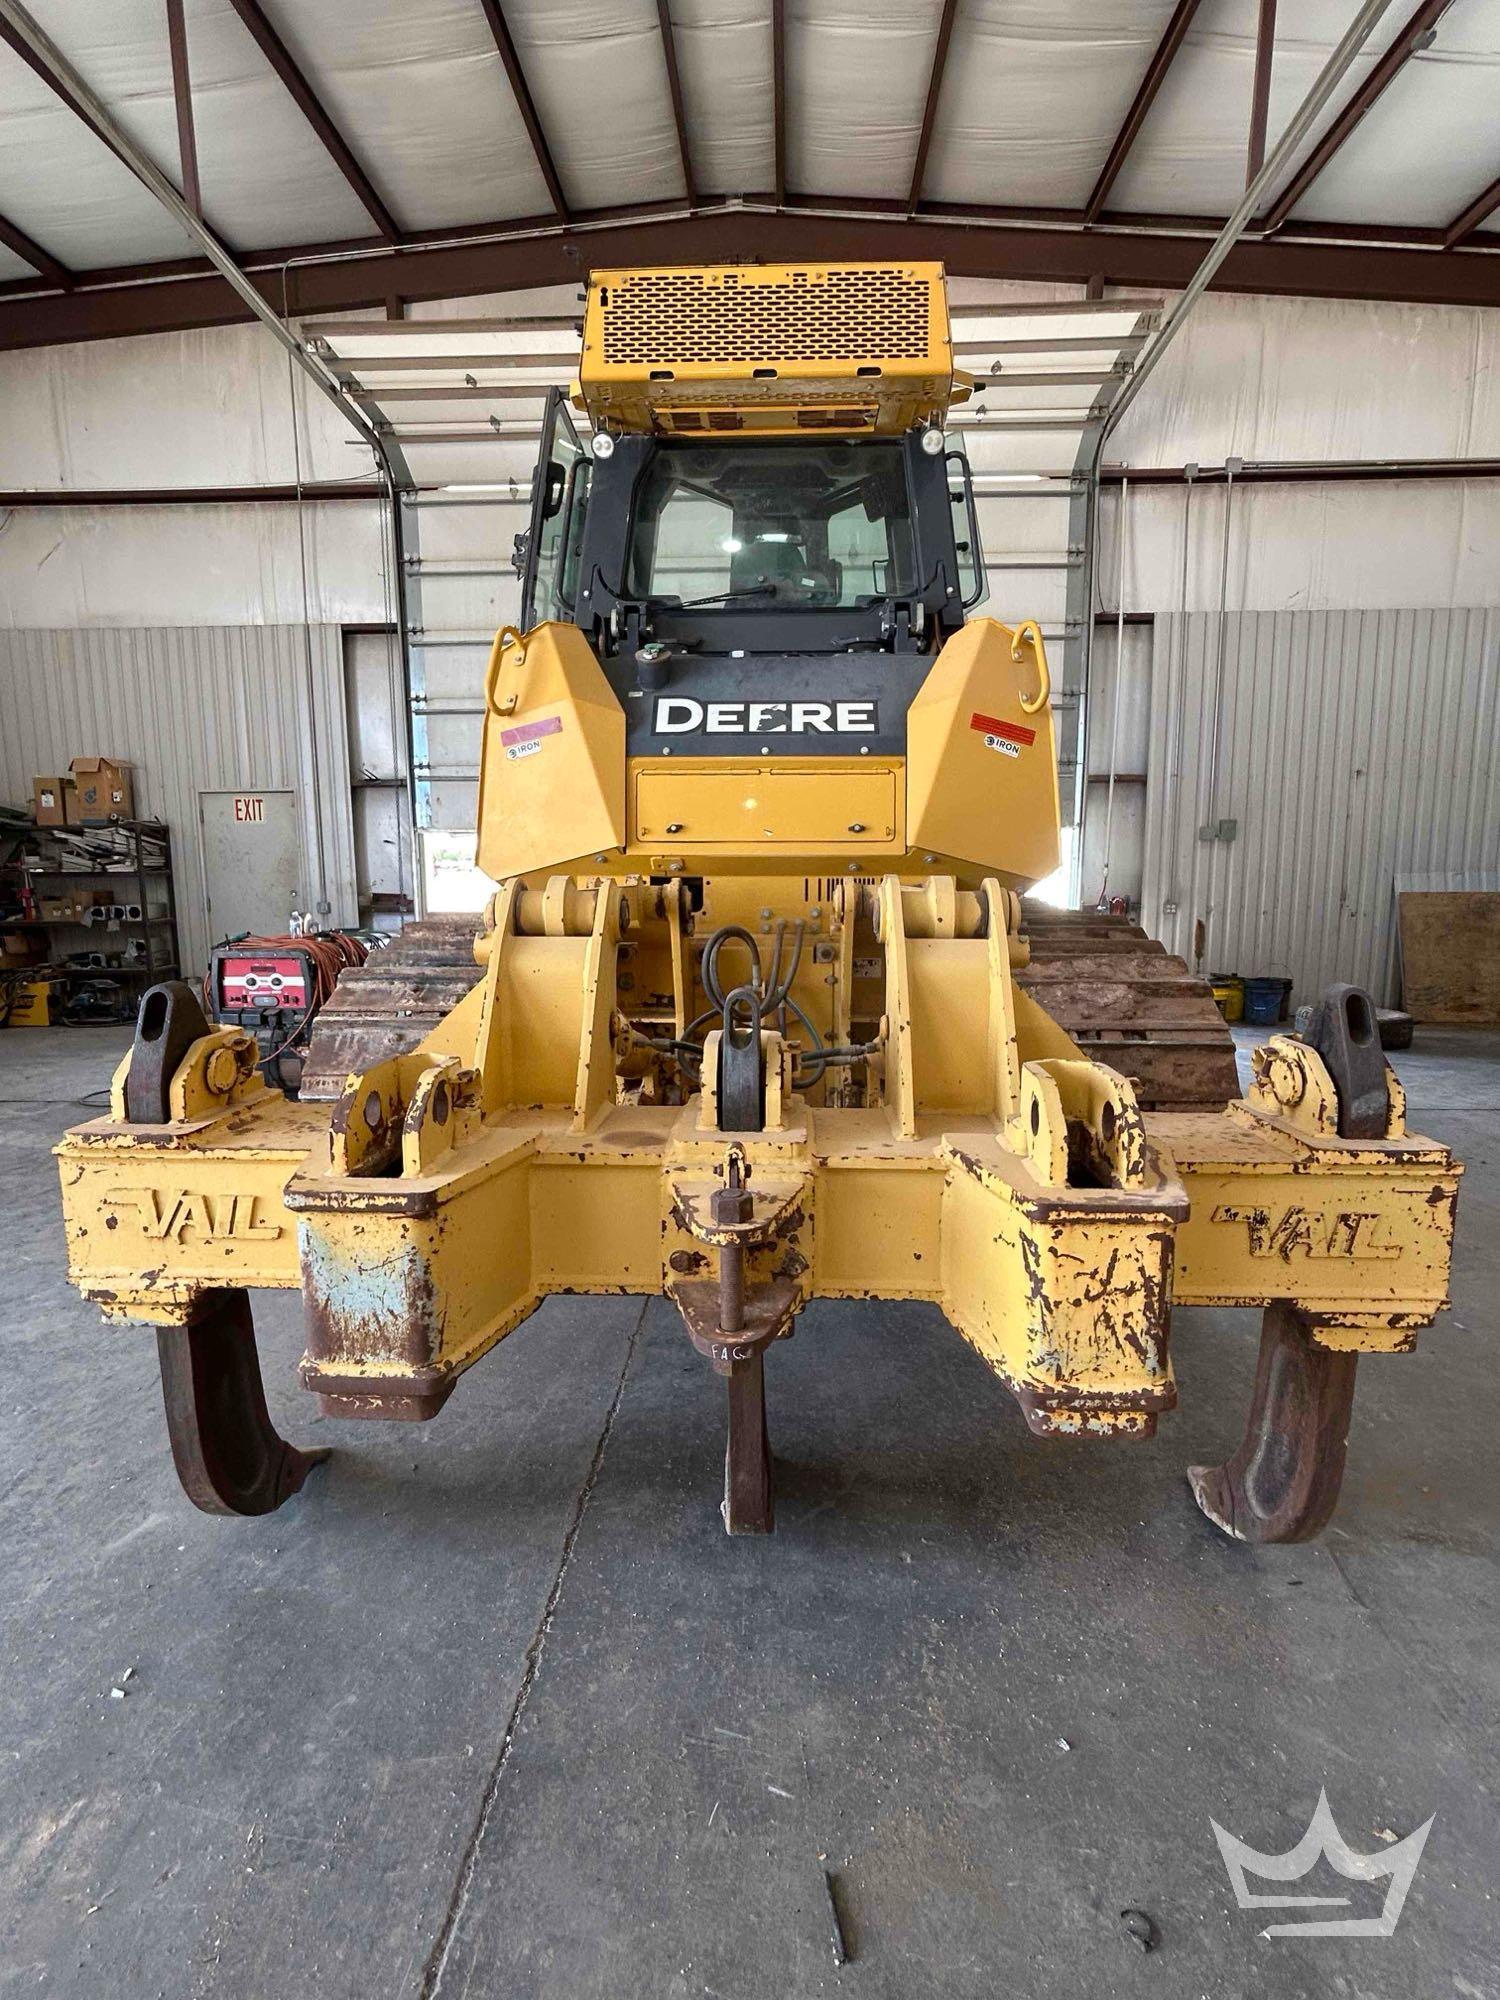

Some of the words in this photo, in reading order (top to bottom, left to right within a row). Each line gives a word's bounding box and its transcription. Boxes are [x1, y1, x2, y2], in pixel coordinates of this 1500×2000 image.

[656, 698, 875, 733] DEERE
[518, 740, 540, 754] IRON
[996, 739, 1019, 754] IRON
[235, 799, 263, 821] EXIT
